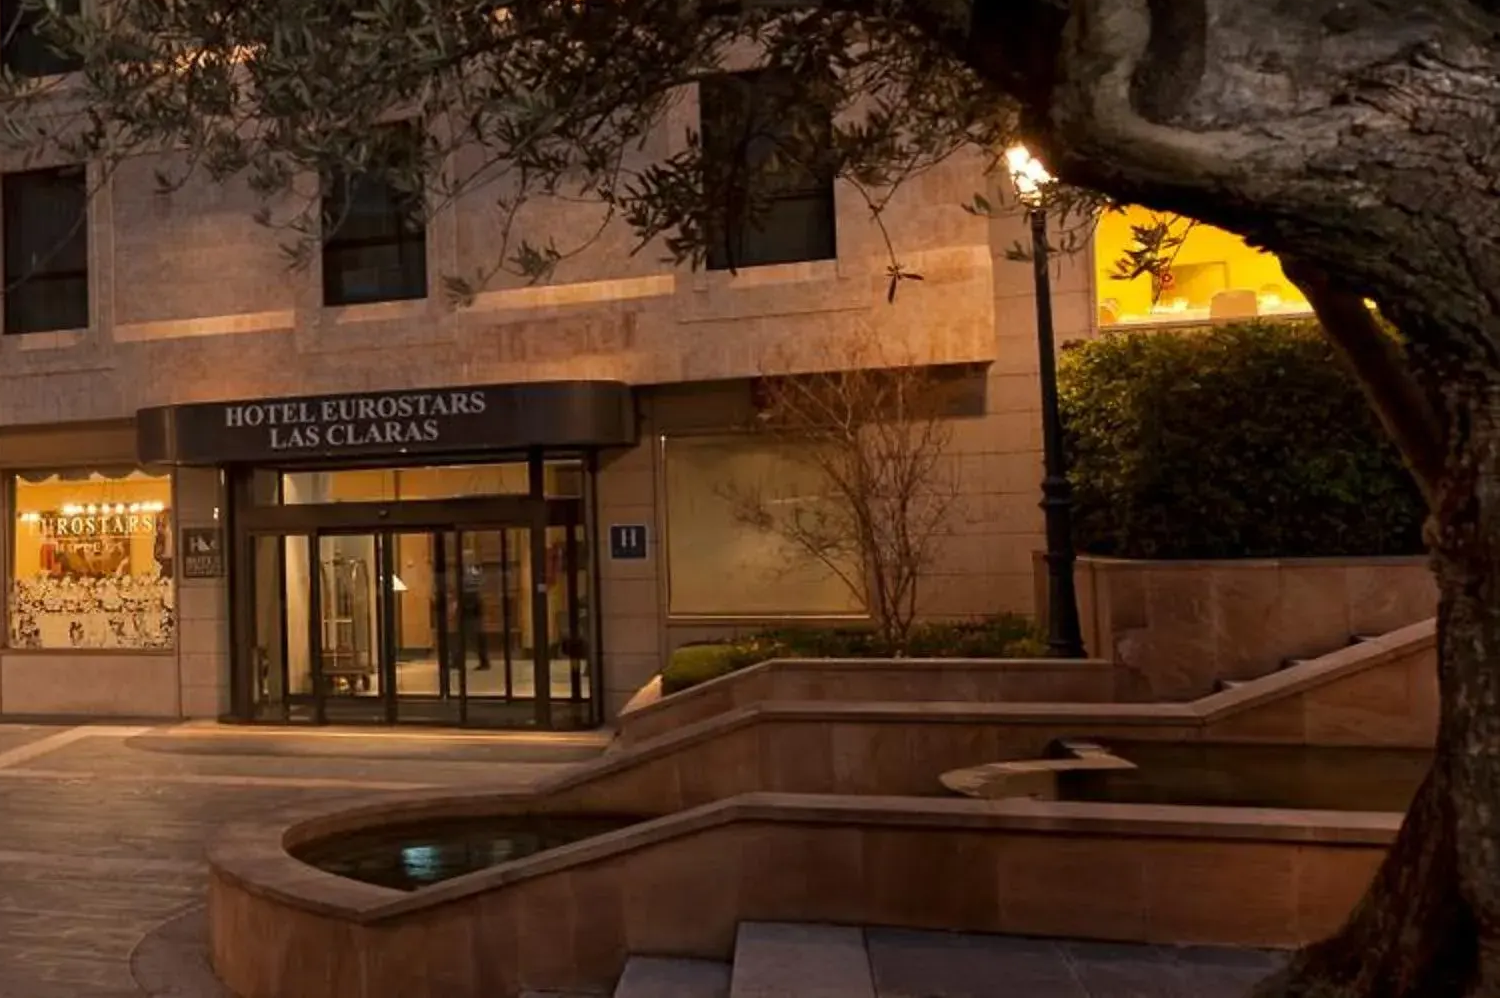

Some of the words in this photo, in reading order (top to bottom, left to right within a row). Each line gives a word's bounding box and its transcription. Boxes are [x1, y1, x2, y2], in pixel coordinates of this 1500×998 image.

[225, 403, 315, 427] HOTEL
[321, 391, 486, 422] EUROSTARS
[270, 425, 320, 448] LAS
[326, 419, 439, 446] CLARAS
